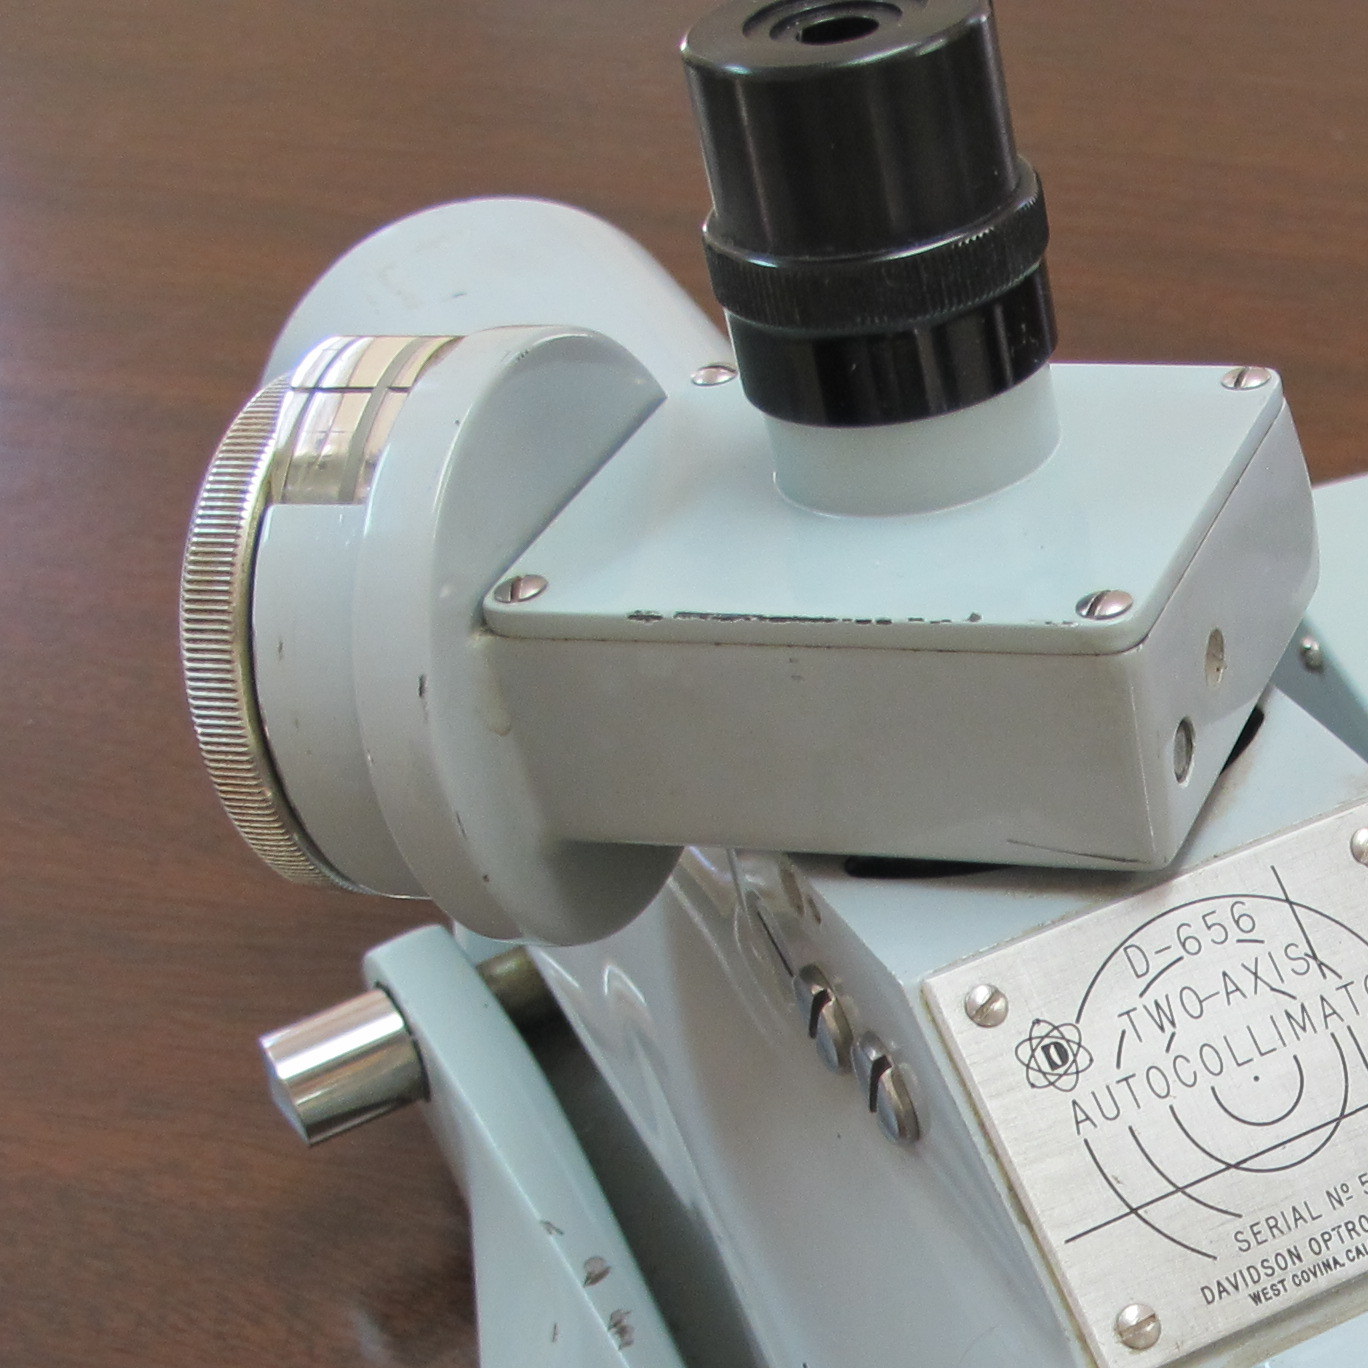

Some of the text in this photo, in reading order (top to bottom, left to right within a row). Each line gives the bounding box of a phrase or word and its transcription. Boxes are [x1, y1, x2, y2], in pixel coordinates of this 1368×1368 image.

[1123, 901, 1256, 979] D-656
[1118, 943, 1311, 1043] TWO-AXIS
[1233, 1200, 1323, 1253] SERIAL
[1200, 1245, 1304, 1305] DAVIDSON
[1248, 1278, 1288, 1306] WEST
